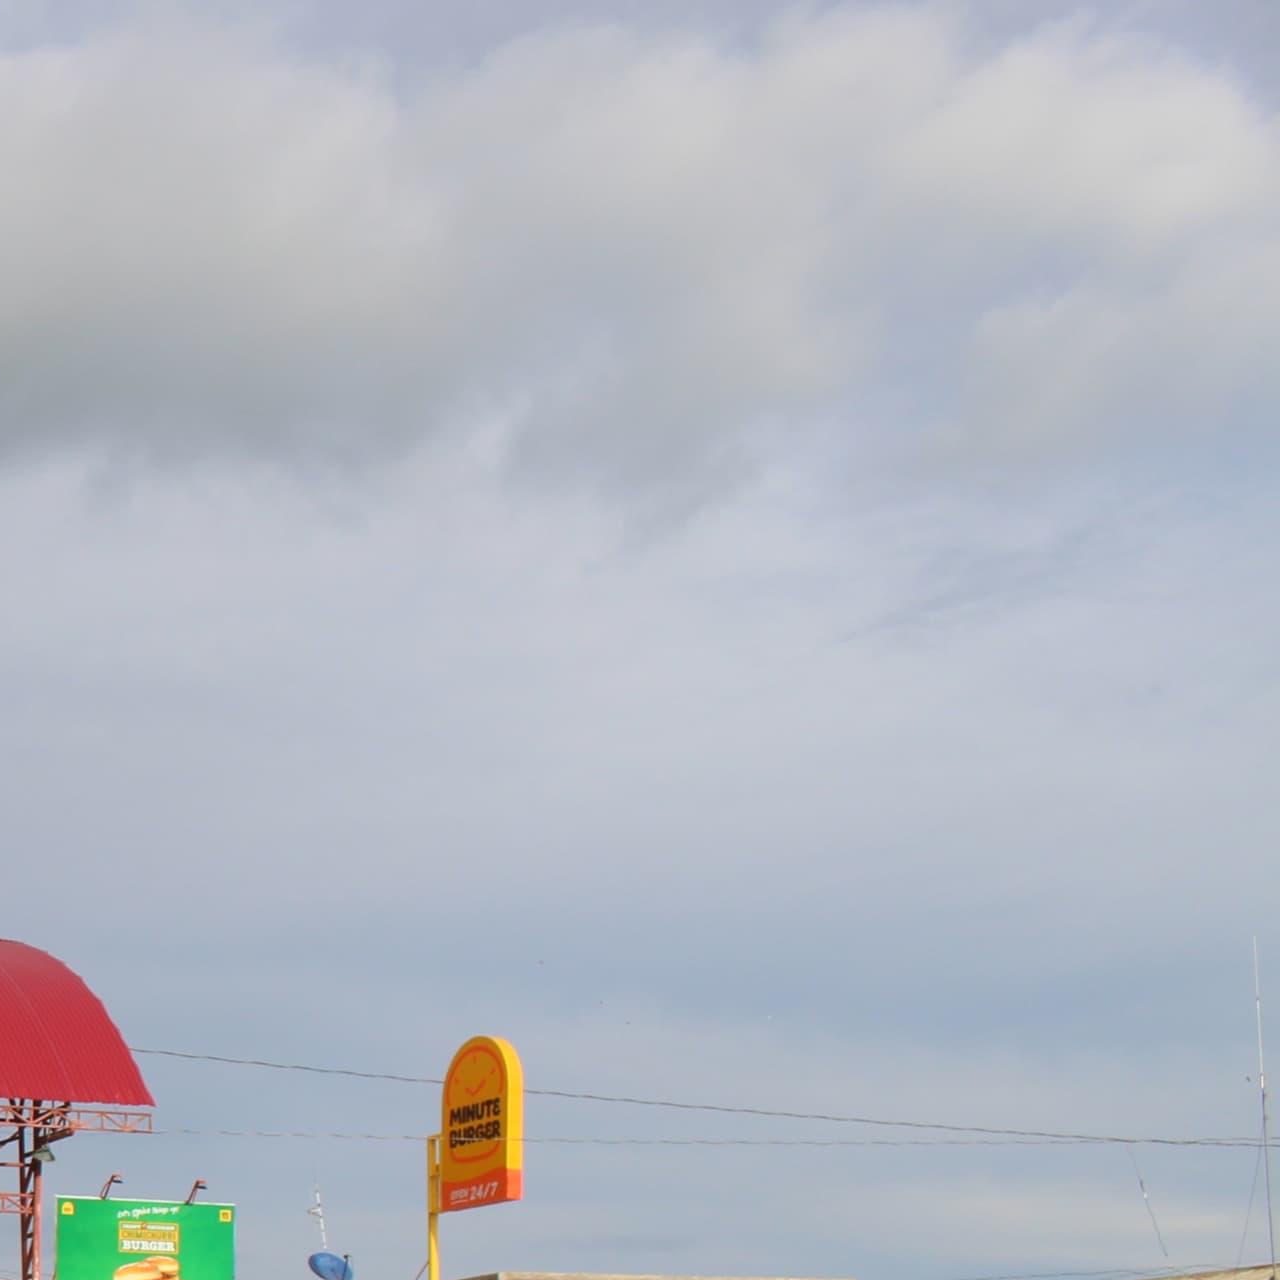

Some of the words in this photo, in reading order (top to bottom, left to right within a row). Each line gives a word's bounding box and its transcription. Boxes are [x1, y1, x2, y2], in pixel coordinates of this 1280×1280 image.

[449, 1098, 501, 1127] MINUTE
[449, 1121, 501, 1148] BURGER
[470, 1181, 498, 1200] 24/7
[121, 1240, 177, 1252] BURGER
